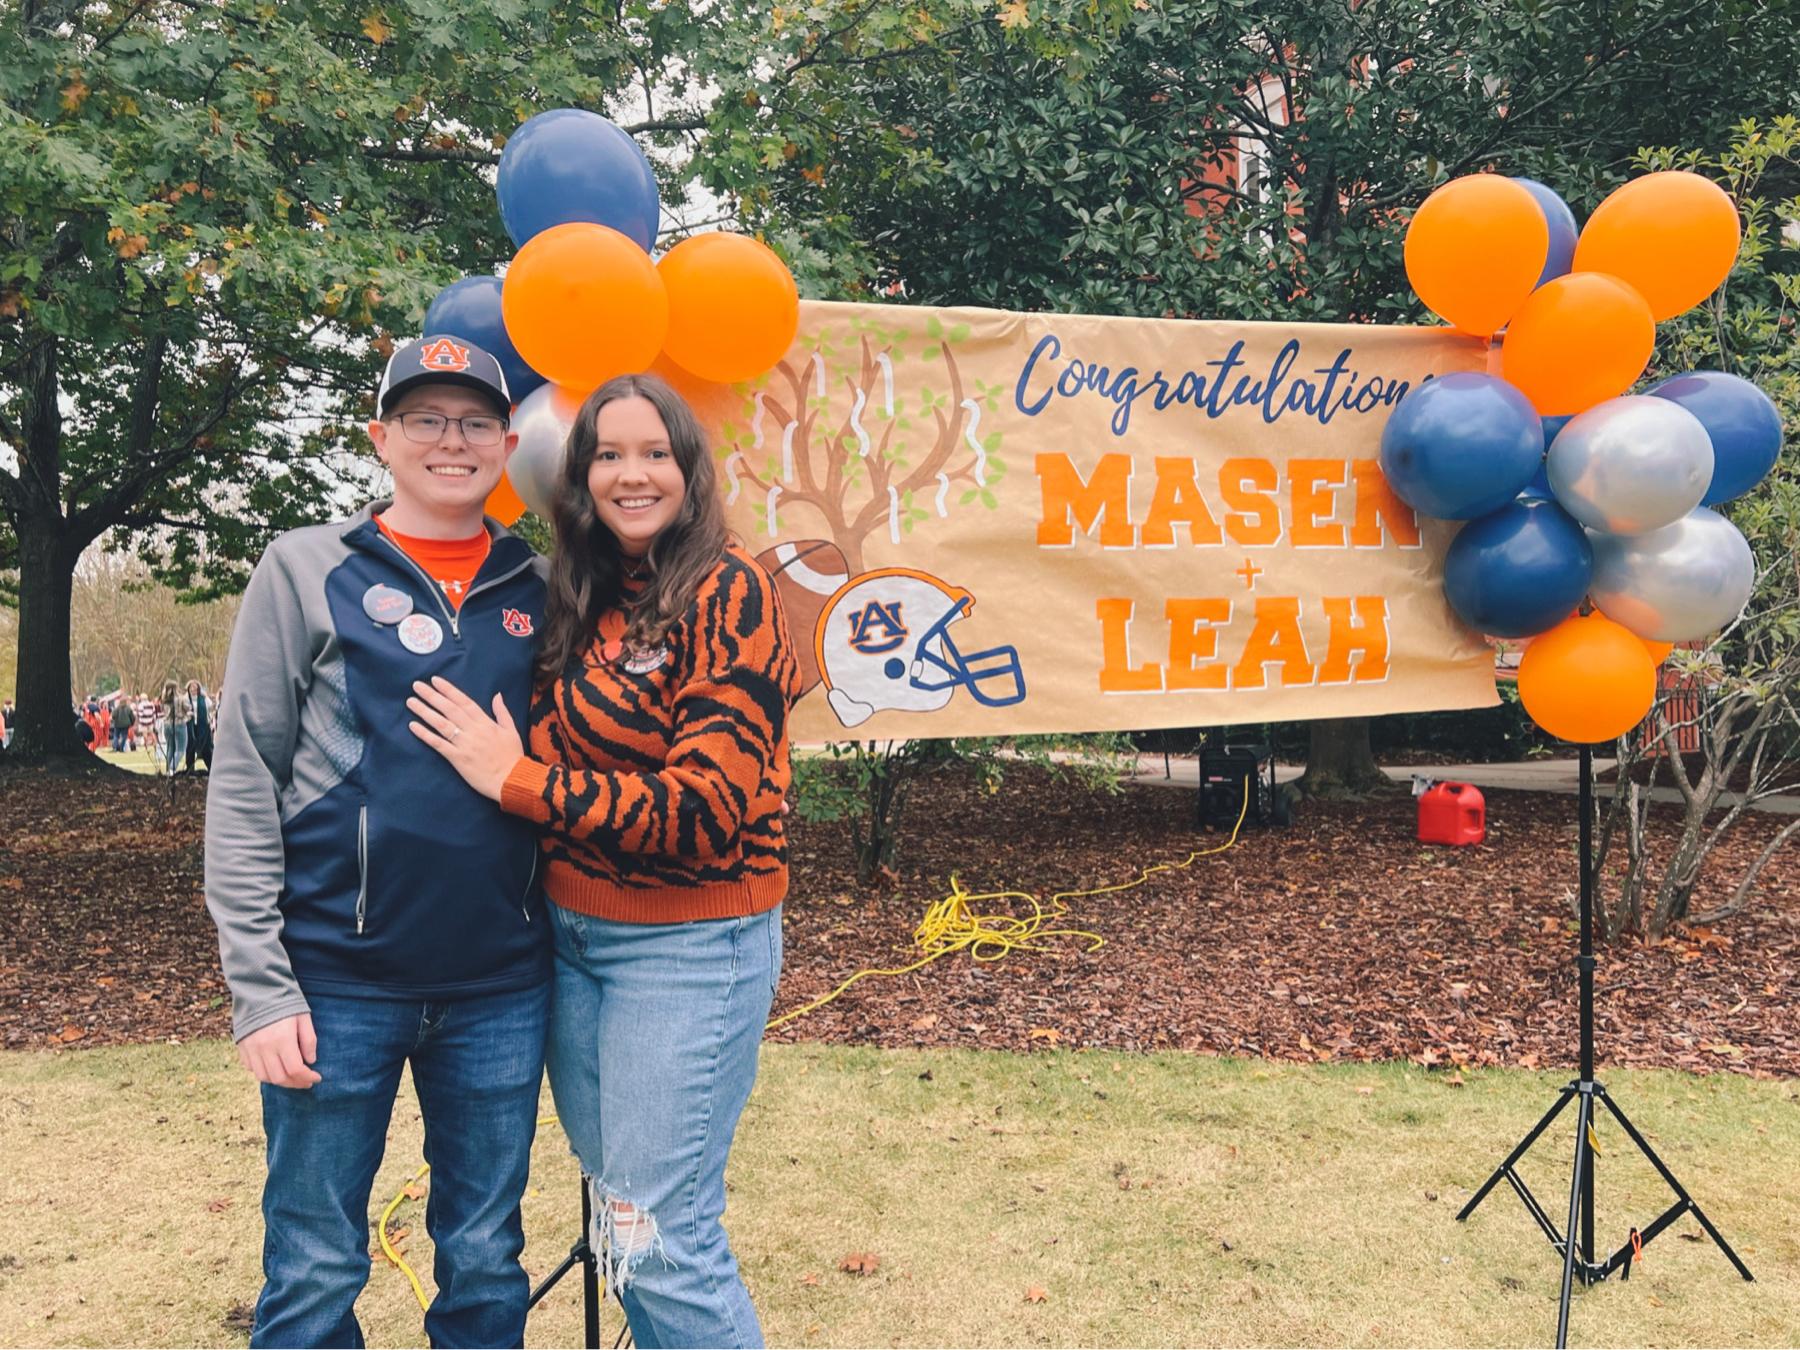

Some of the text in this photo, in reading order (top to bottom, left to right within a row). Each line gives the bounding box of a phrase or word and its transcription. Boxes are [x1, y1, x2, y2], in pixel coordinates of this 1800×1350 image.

[1015, 334, 1434, 436] Congratulation
[1035, 452, 1423, 550] MASEN
[1236, 558, 1264, 590] +
[1096, 596, 1391, 695] LEAH
